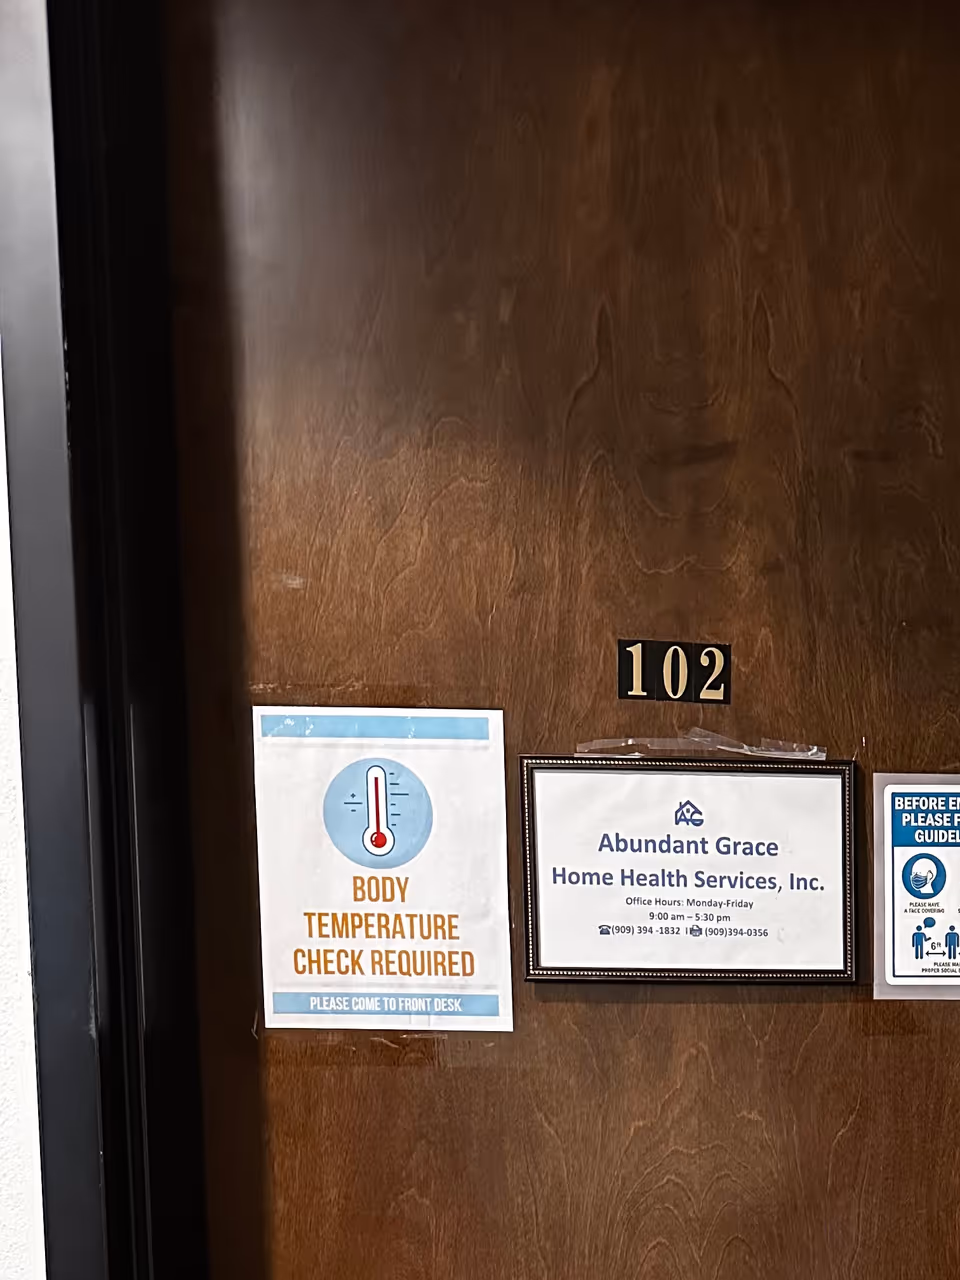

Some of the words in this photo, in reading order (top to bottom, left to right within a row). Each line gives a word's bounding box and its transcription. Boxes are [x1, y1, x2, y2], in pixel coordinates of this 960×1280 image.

[626, 643, 725, 700] 102
[894, 797, 946, 810] BEFORE
[902, 813, 951, 826] PLEASE
[598, 833, 709, 855] Abundant
[715, 836, 779, 857] Grace
[353, 875, 409, 902] BODY
[552, 867, 614, 885] Home
[620, 868, 688, 888] Health
[694, 870, 783, 893] Services,
[790, 873, 825, 891] Inc.
[625, 897, 652, 906] Office
[654, 898, 685, 907] Hours:
[686, 898, 754, 909] Monday-Friday
[303, 912, 460, 940] TEMPERATURE
[649, 912, 669, 921] 9:00
[695, 913, 714, 922] 5:30
[717, 914, 731, 923] pm
[611, 926, 635, 935] (909)
[637, 926, 653, 934] 394
[704, 927, 769, 937] (909)394-0356
[293, 948, 366, 975] CHECK
[371, 949, 475, 977] REQUIRED
[310, 996, 349, 1010] PLEASE
[352, 997, 380, 1011] COME
[384, 997, 395, 1011] TO
[399, 997, 431, 1011] FRONT
[434, 998, 462, 1012] DESK
